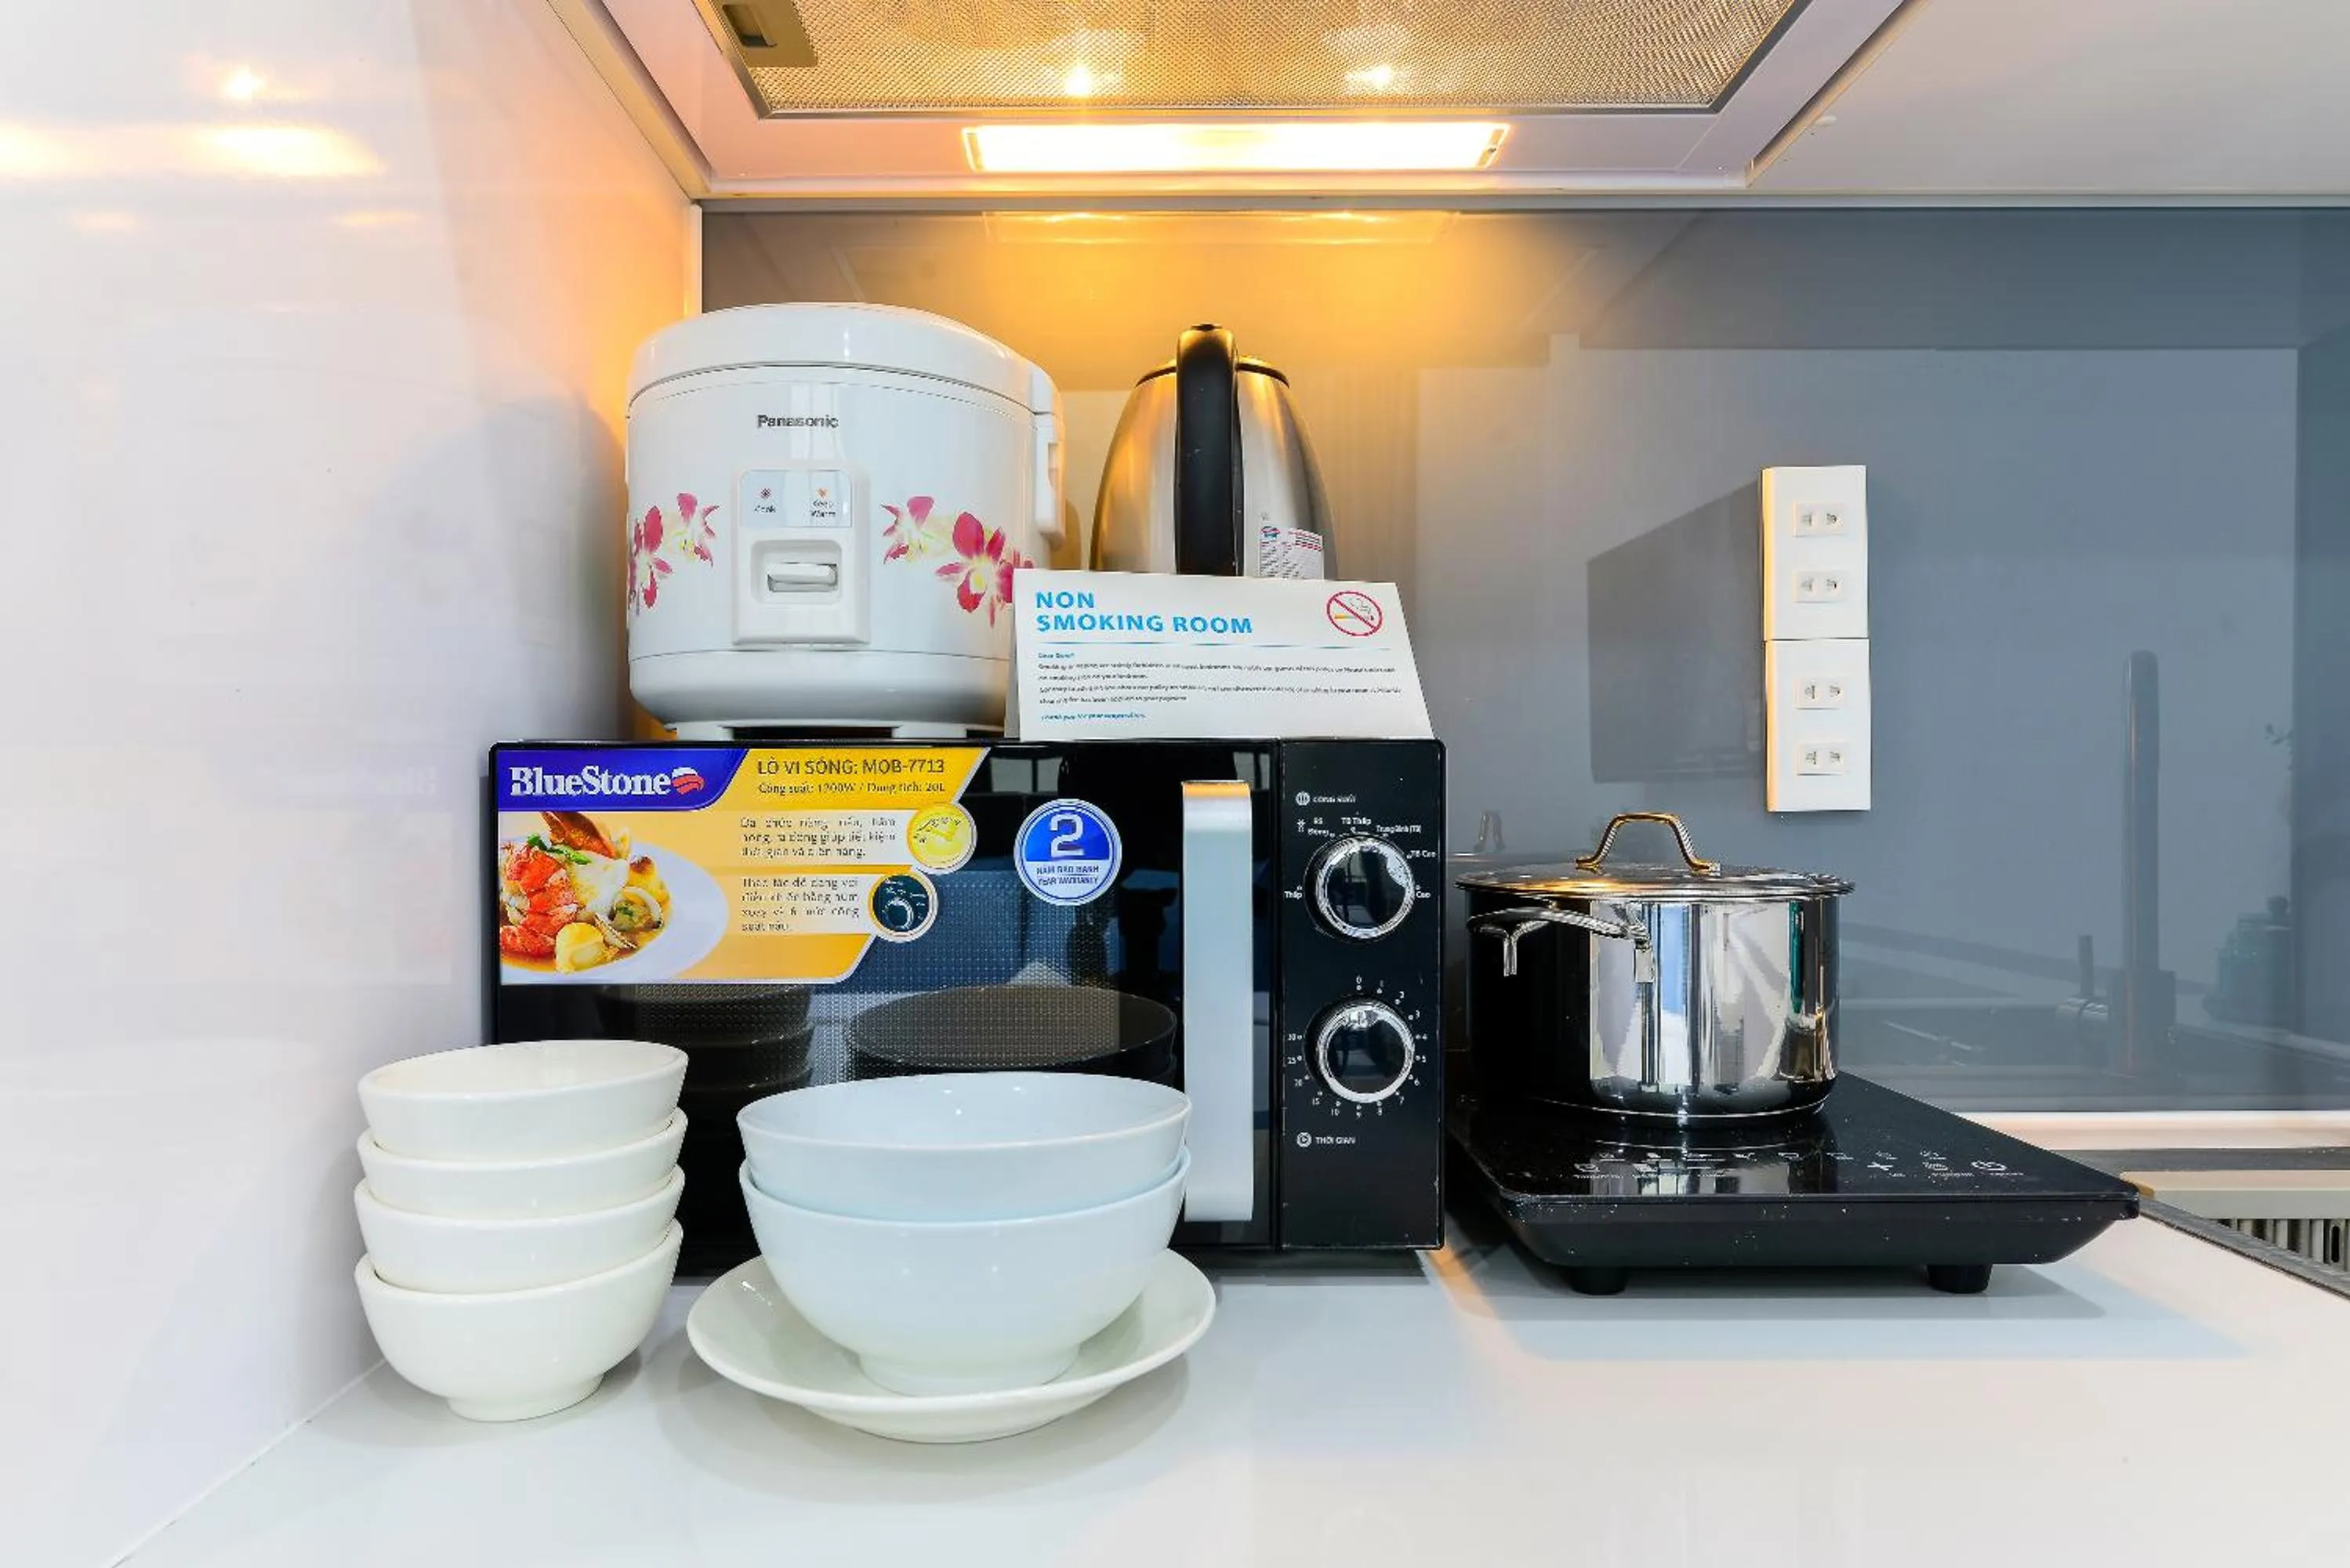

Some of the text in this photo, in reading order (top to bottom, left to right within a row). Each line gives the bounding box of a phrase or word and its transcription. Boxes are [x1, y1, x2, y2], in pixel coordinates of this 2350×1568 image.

[757, 415, 839, 428] Panasonic
[1035, 591, 1095, 609] NON
[1036, 614, 1253, 634] SMOKING ROOM
[758, 757, 779, 774] LÒ
[784, 760, 800, 774] VI
[862, 759, 945, 774] MOB-7713
[509, 765, 672, 797] BlueStone
[759, 783, 785, 796] Công
[926, 783, 946, 793] 20L
[1050, 813, 1084, 858] 2
[1285, 891, 1303, 900] Thấp
